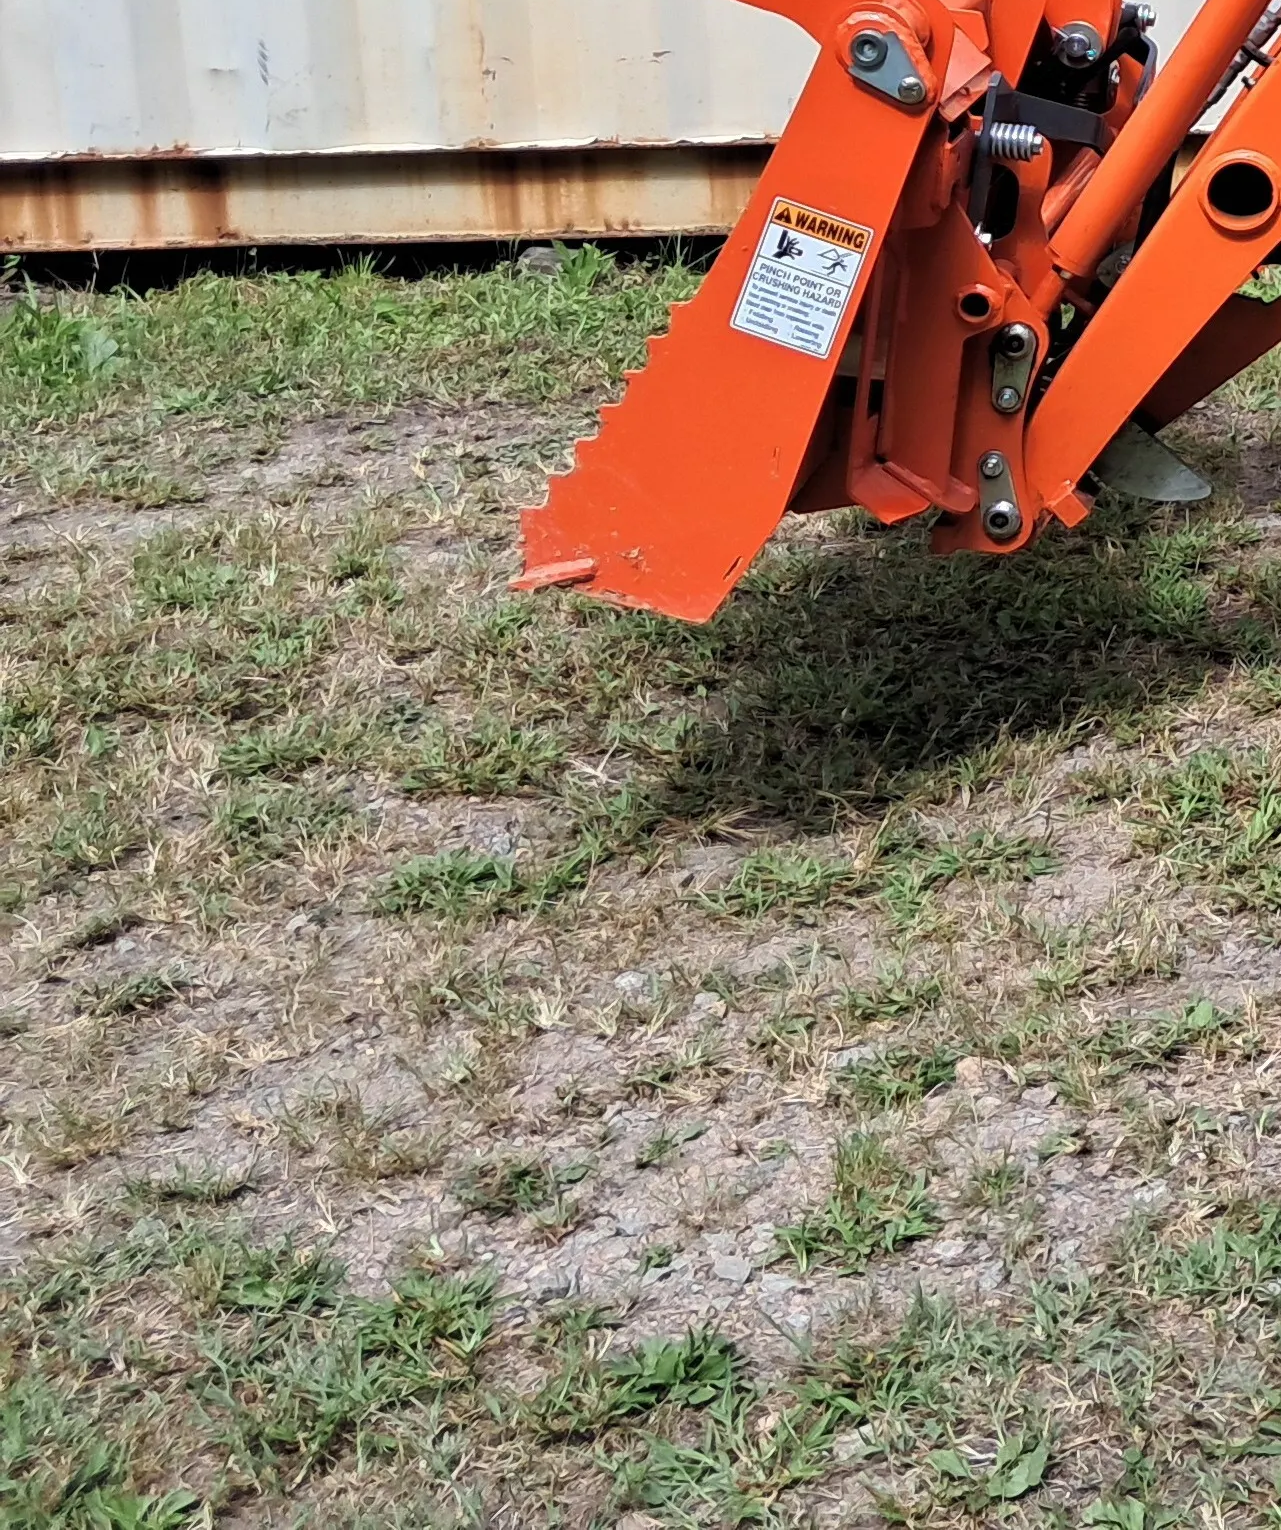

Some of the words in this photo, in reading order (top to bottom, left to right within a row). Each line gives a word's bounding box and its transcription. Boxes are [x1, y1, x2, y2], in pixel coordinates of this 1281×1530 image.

[795, 211, 865, 249] WARNING
[753, 272, 800, 295] CRUSHING
[803, 289, 841, 308] HAZARD
[760, 263, 791, 280] PINCH
[793, 275, 825, 290] POINT
[826, 287, 841, 298] OR
